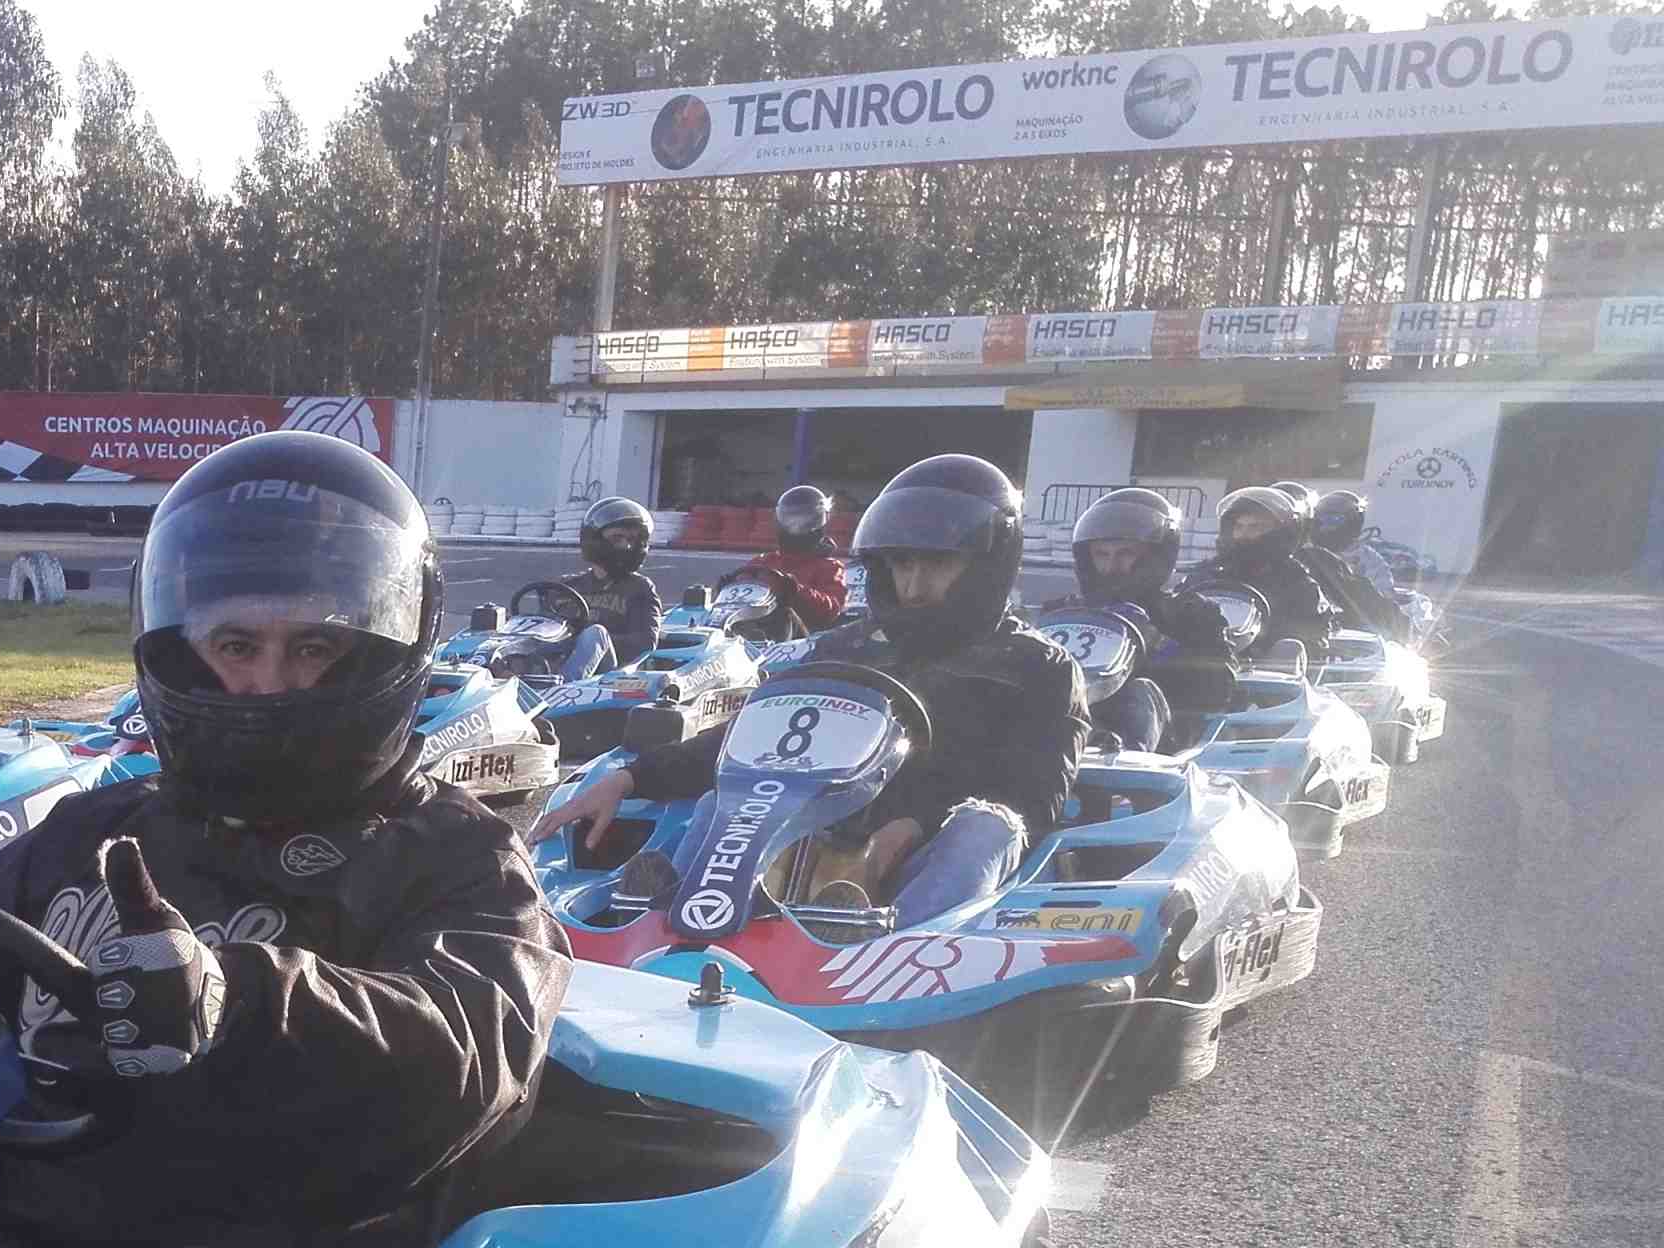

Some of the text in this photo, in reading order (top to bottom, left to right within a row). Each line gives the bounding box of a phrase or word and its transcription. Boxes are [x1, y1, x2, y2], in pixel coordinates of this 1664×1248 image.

[1023, 61, 1118, 91] worknc
[1225, 30, 1572, 101] TECNIROLO
[562, 102, 631, 121] ZW3D
[728, 74, 994, 136] TECNIROLO
[756, 144, 833, 158] ENGENHARIA
[875, 324, 950, 344] HASCO
[1034, 319, 1116, 339] HASCO
[1208, 314, 1298, 335] HASCO
[597, 335, 660, 354] HASCO
[731, 329, 799, 349] HASCO
[45, 415, 266, 440] CENTROS MAQUINAÇÃO
[90, 443, 138, 458] ALTA
[761, 696, 871, 714] EUROINDY
[423, 713, 485, 758] ECNIROLO
[777, 707, 820, 760] 8
[700, 780, 785, 887] TECNIROLO
[1051, 907, 1135, 931] eni
